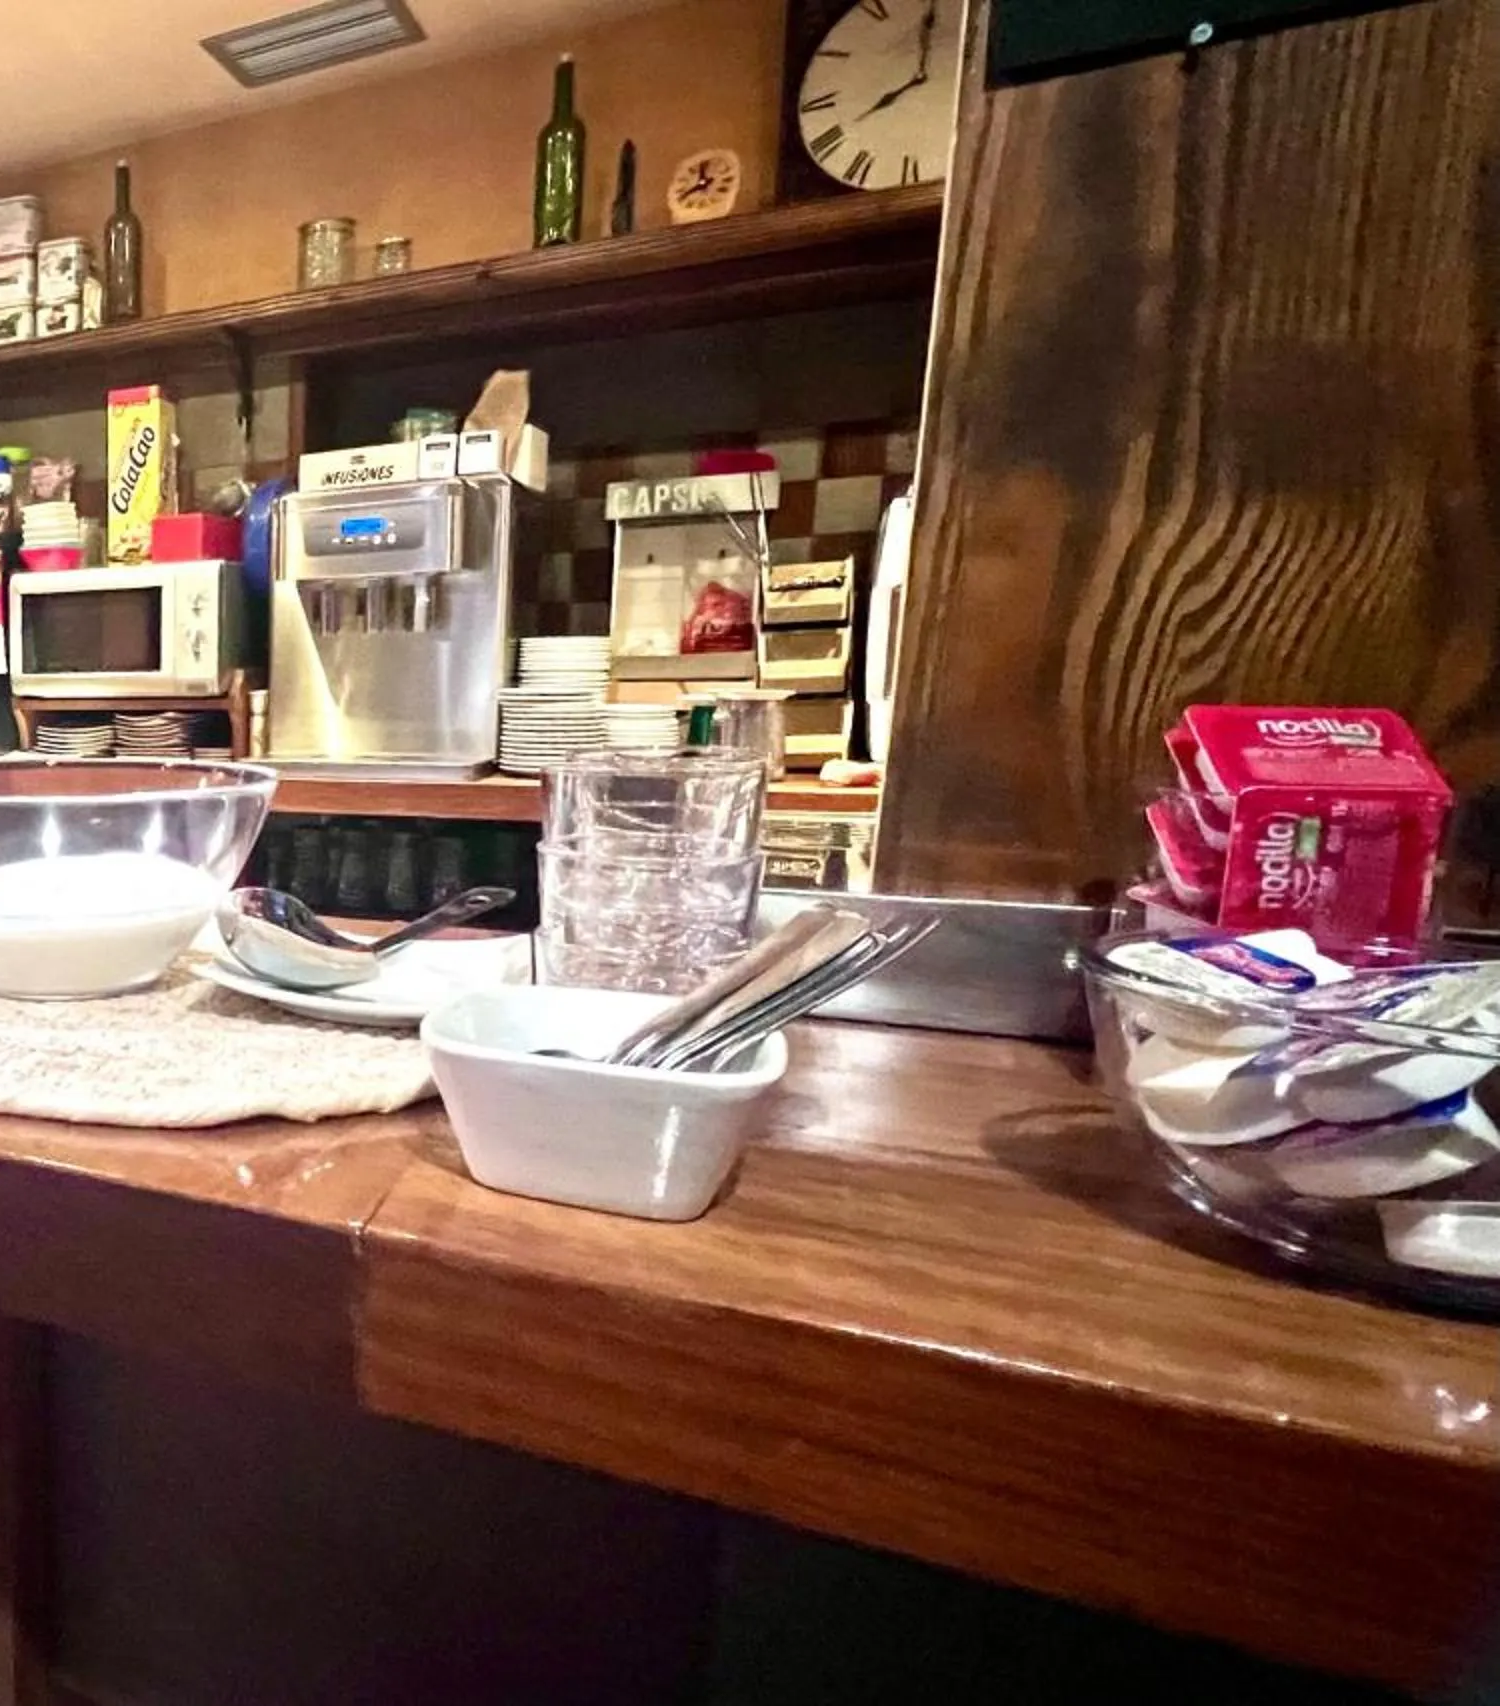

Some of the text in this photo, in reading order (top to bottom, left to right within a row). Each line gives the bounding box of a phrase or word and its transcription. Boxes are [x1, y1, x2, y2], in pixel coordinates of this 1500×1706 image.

[111, 425, 156, 515] ColaCao
[1256, 717, 1370, 737] nocilla
[1256, 822, 1295, 908] nocilla
